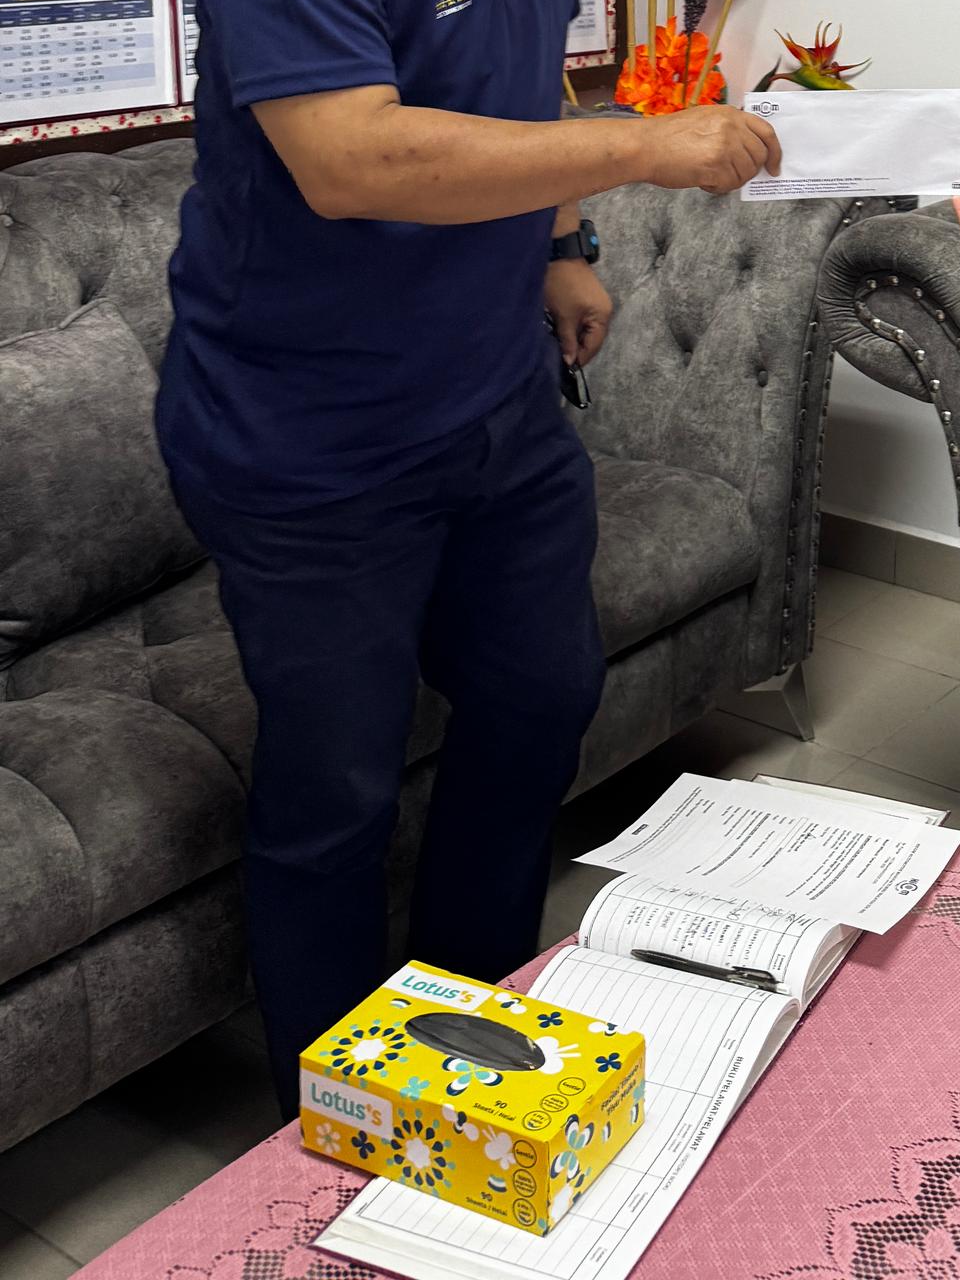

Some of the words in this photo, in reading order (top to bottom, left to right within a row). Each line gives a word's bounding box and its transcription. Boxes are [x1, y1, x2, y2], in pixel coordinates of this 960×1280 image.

[401, 974, 476, 1003] Lotus's
[311, 1082, 382, 1127] Lotus's
[494, 1099, 508, 1109] 90
